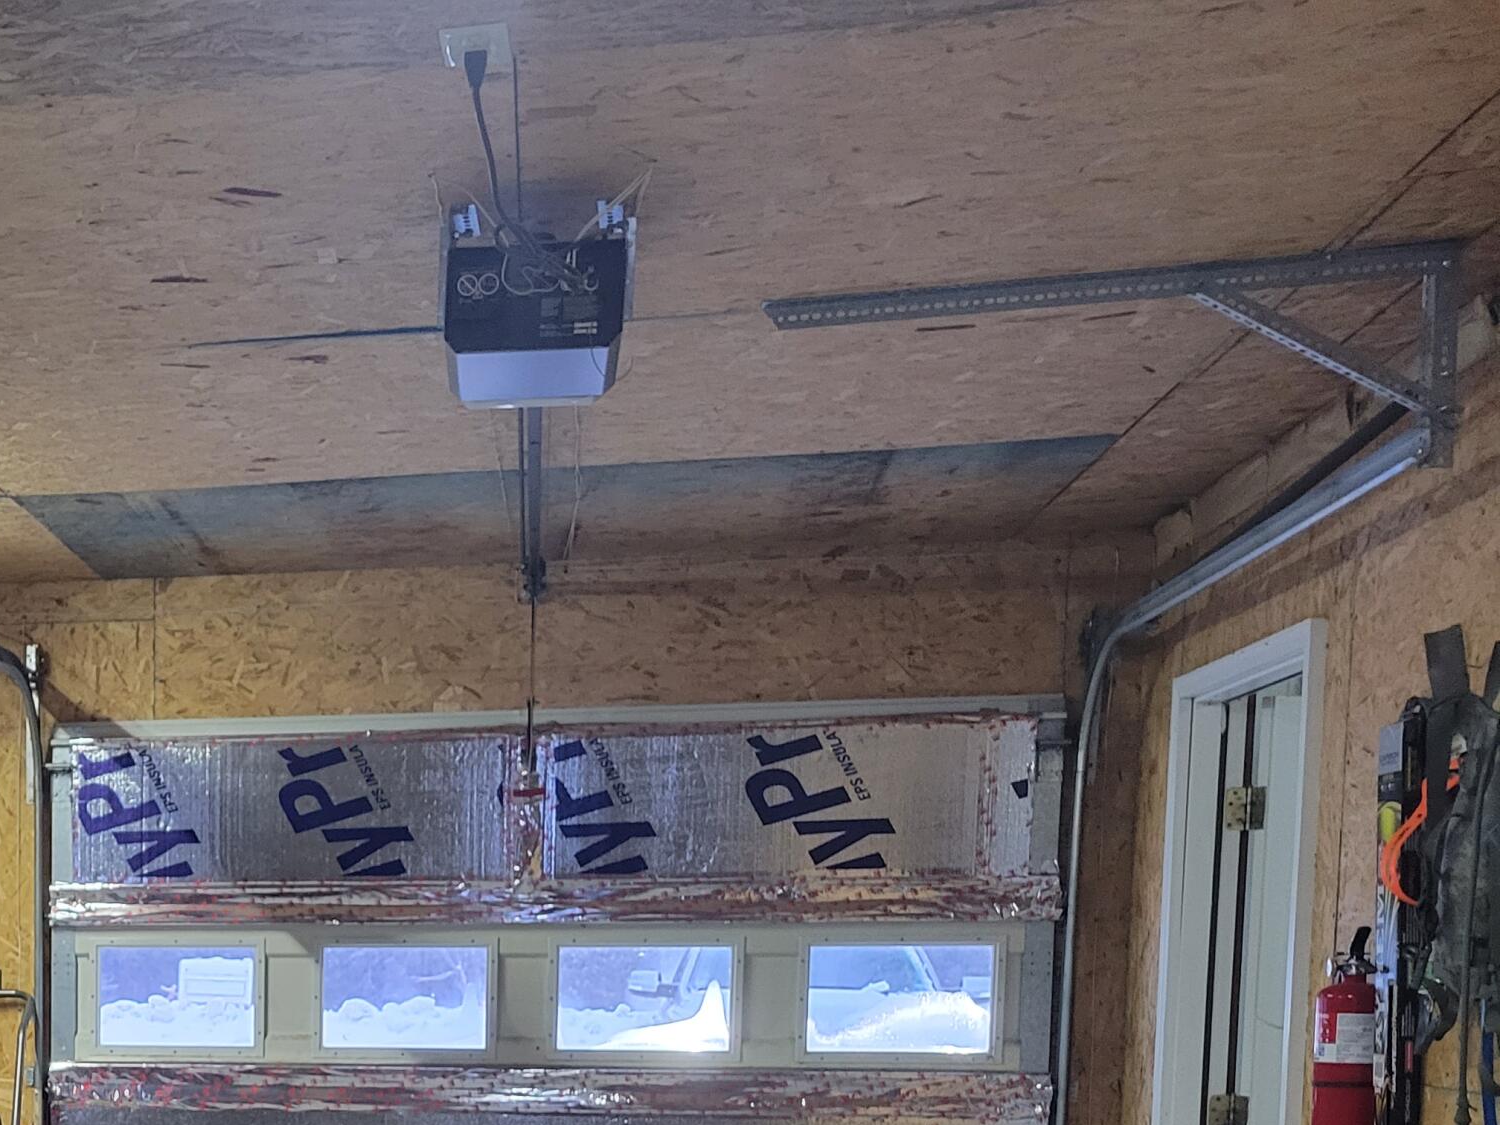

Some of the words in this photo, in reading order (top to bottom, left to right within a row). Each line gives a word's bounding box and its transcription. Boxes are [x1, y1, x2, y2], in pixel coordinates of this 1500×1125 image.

[823, 730, 859, 776] INSULA
[371, 788, 392, 811] EPS
[613, 782, 633, 805] EPS
[850, 777, 871, 801] EPS
